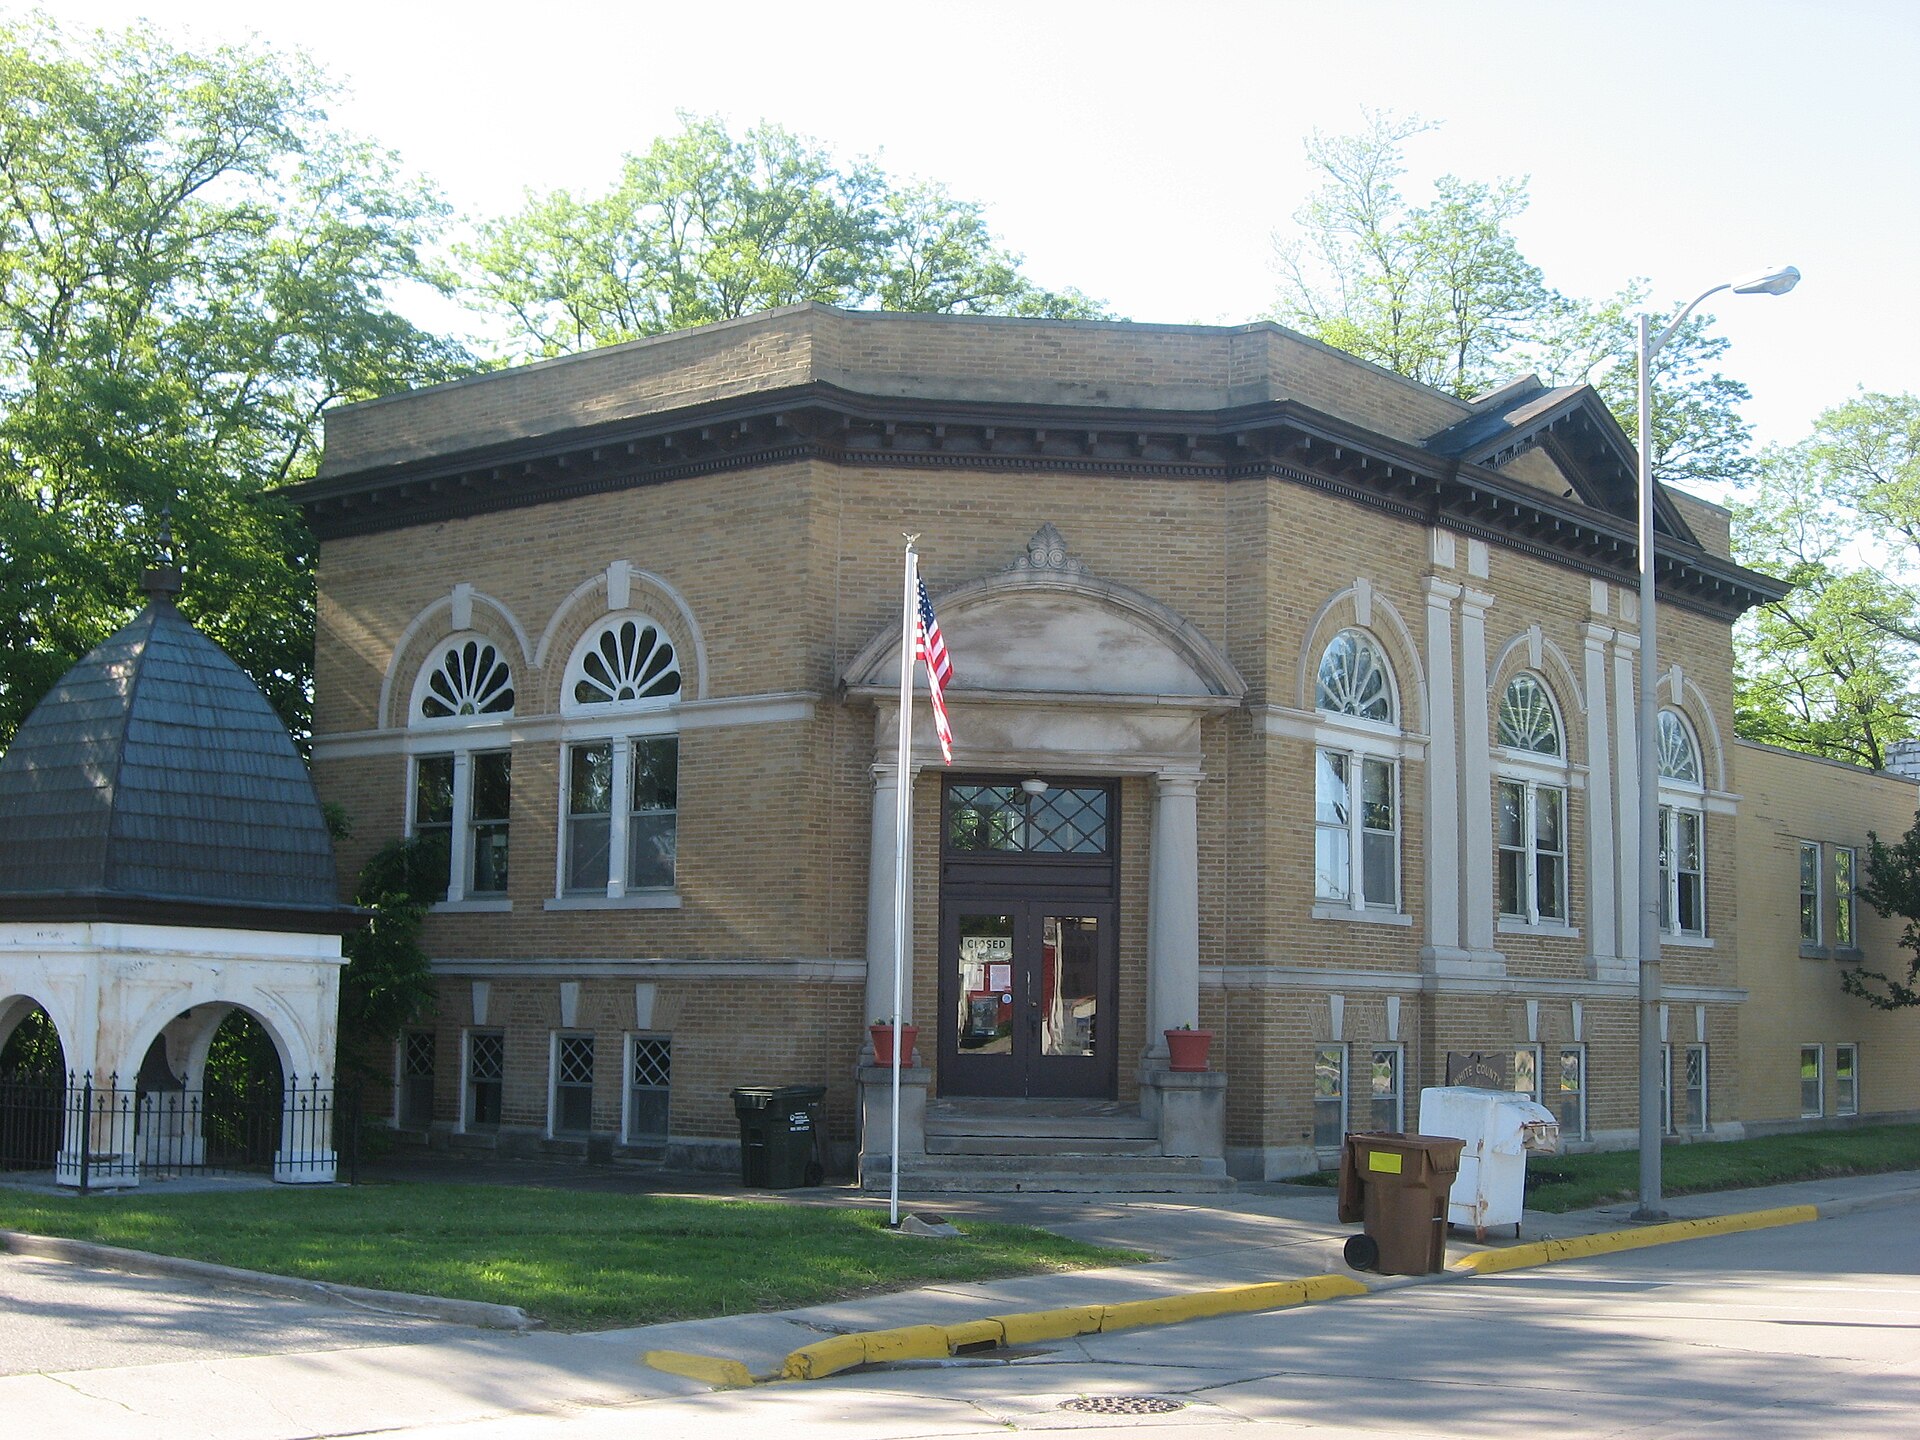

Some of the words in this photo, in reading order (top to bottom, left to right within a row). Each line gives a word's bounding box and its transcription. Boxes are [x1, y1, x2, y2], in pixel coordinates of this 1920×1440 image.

[967, 939, 1006, 949] CLOSED
[1453, 1065, 1472, 1086] WHITE
[1476, 1063, 1501, 1085] COUNTY
